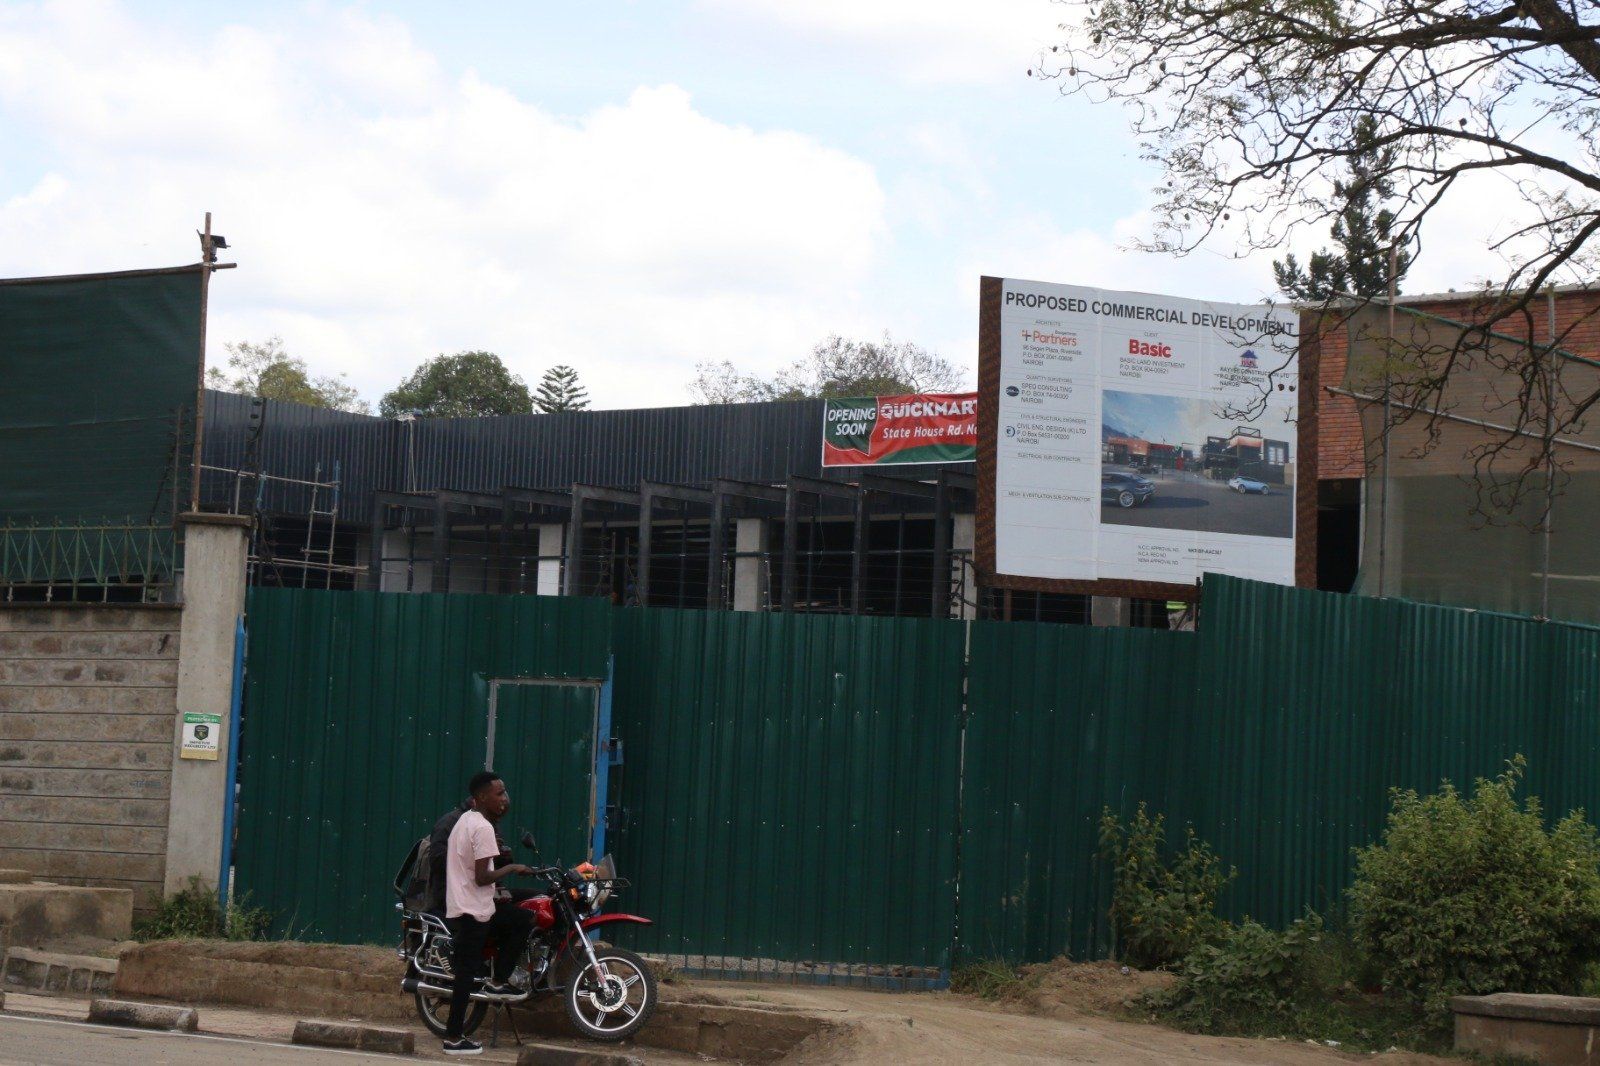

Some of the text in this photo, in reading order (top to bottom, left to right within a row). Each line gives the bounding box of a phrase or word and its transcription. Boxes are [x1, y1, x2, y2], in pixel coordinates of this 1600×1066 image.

[1005, 291, 1294, 334] PROPOSED COMMERCIAL DEVELOPMENT
[1033, 330, 1077, 347] Partners
[1129, 338, 1172, 358] Basic
[1120, 356, 1136, 364] BASIC
[1153, 361, 1186, 369] INVESTMENT
[1038, 384, 1072, 394] CONSULTING
[828, 407, 876, 422] OPENING
[836, 422, 867, 436] SOON
[883, 427, 910, 439] State
[914, 426, 943, 438] House
[947, 424, 964, 436] Rd.
[1046, 425, 1067, 433] DESIGN
[1017, 437, 1040, 445] NAIROBI
